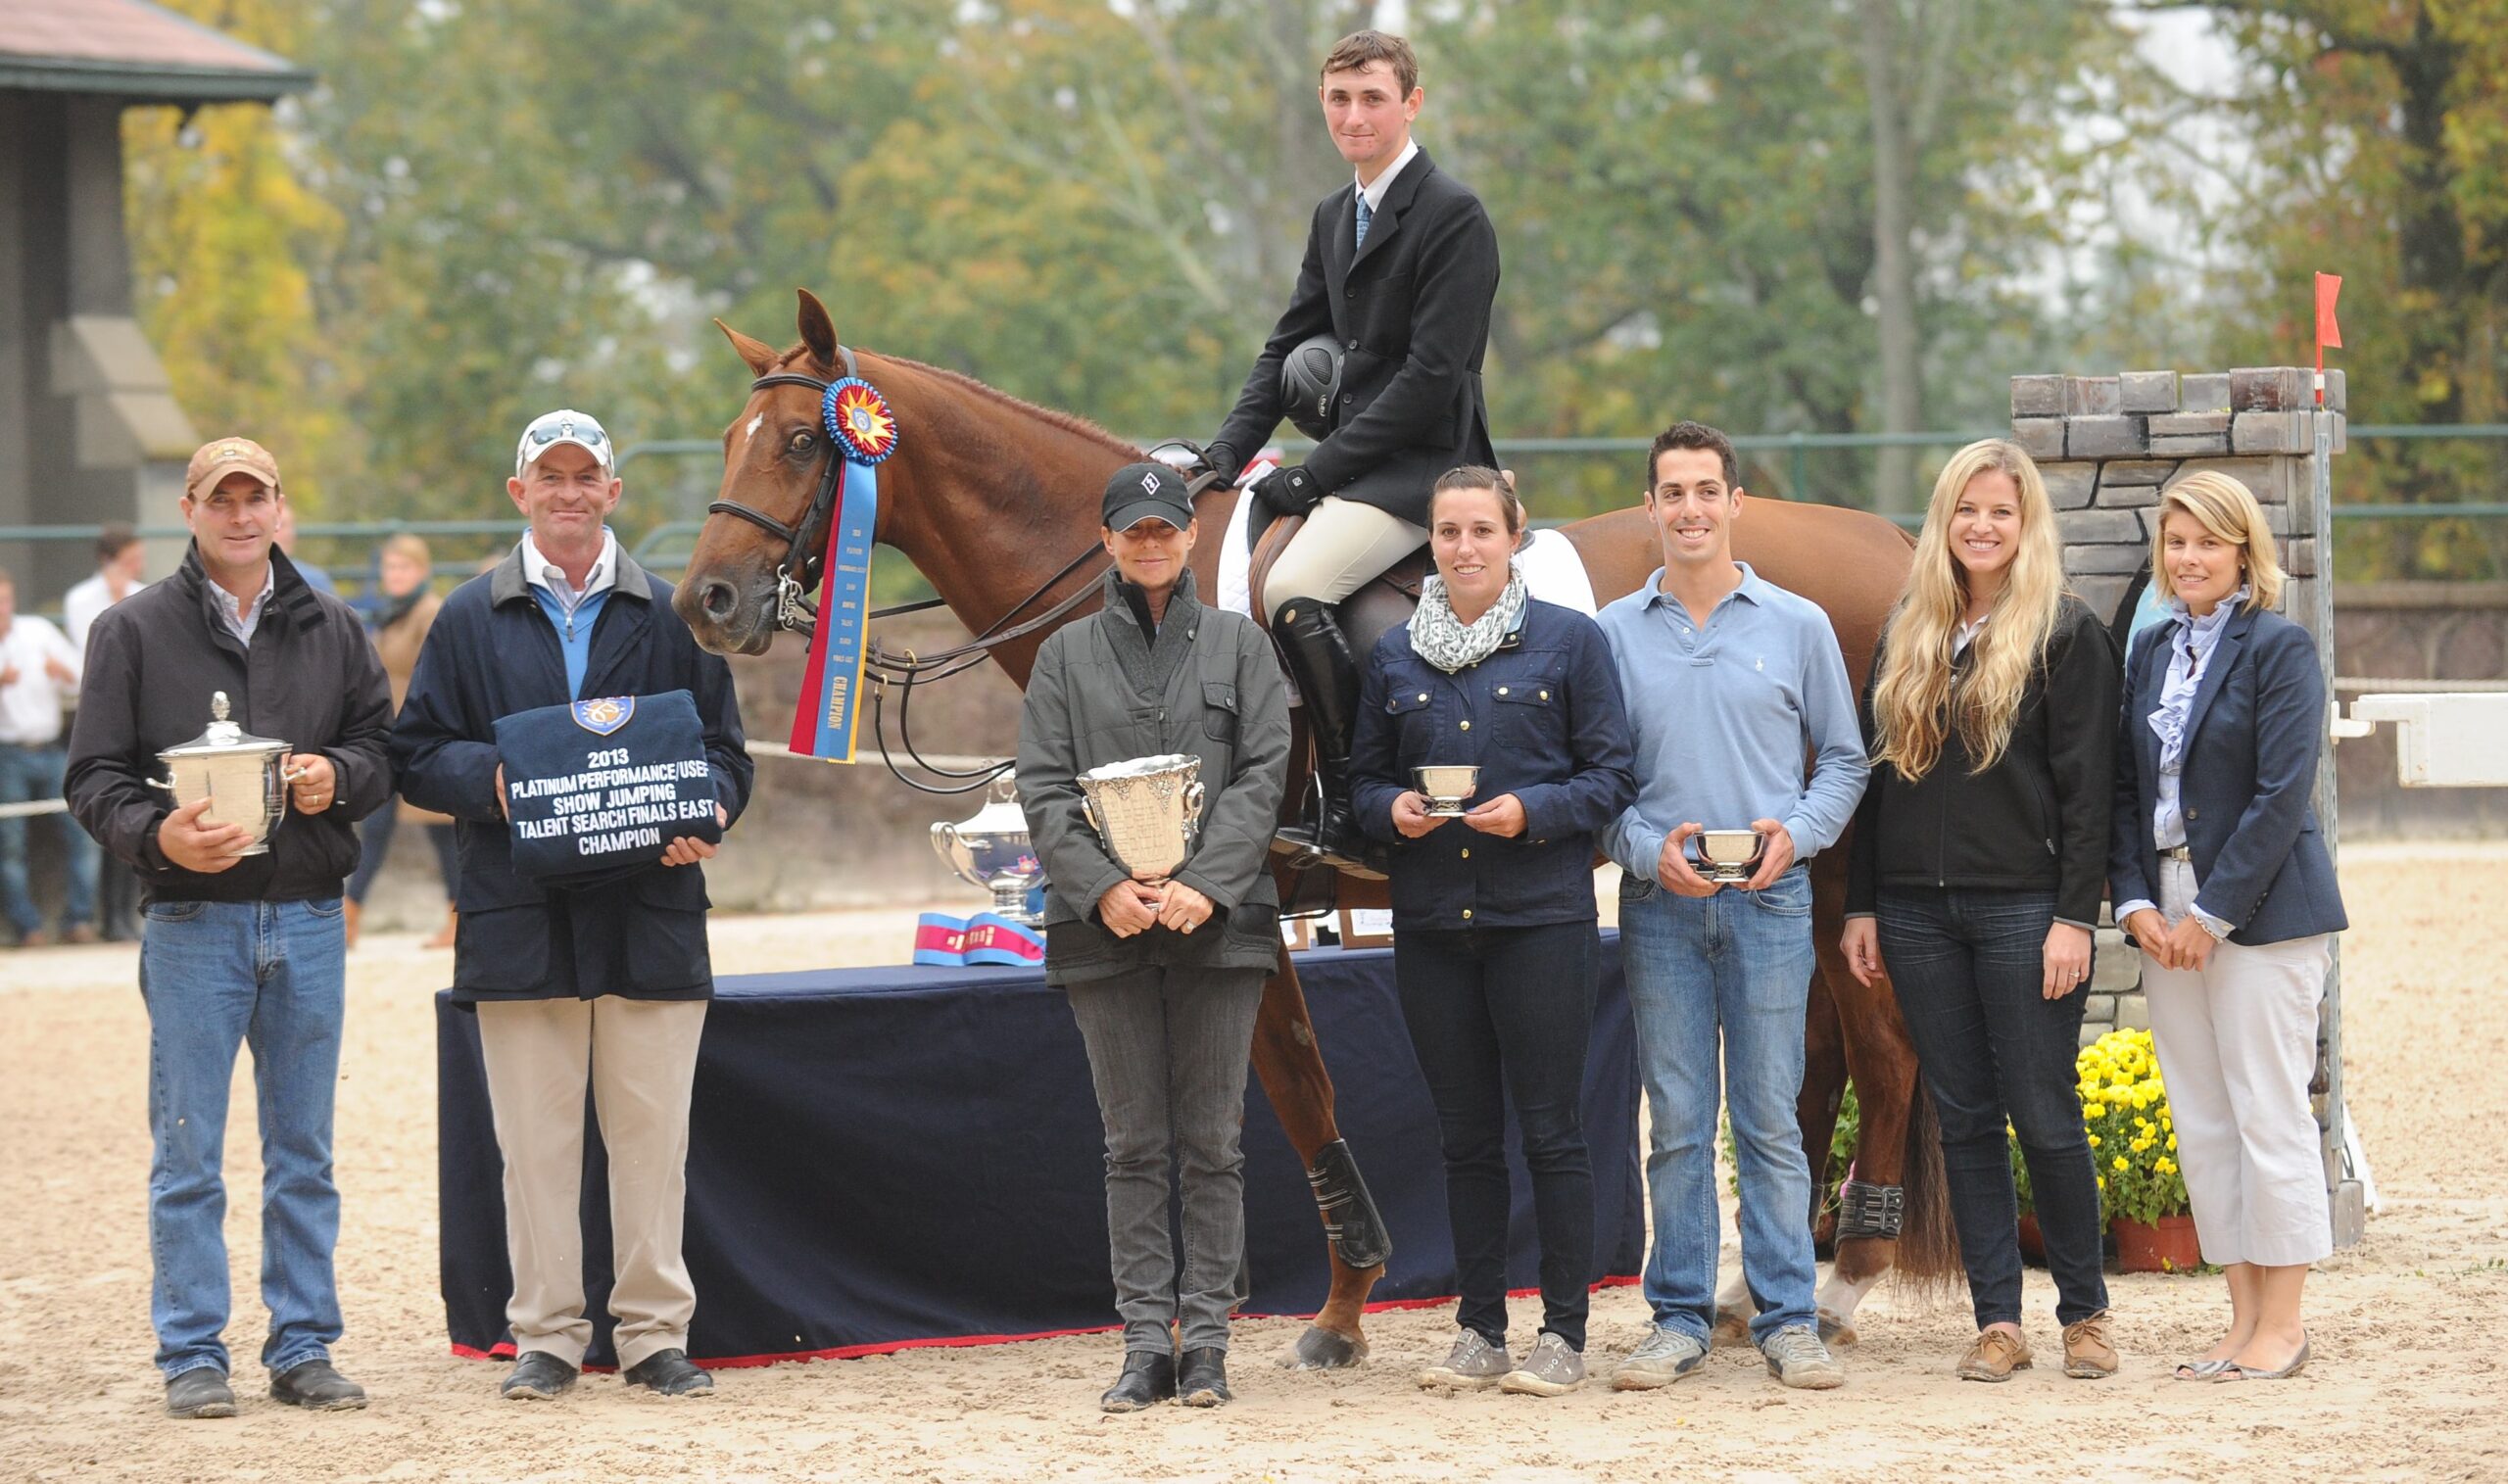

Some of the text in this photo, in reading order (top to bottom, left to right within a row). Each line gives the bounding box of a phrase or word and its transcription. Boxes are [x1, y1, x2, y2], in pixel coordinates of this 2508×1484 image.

[827, 676, 848, 730] CHAMPION
[588, 747, 629, 769] 2013
[510, 774, 578, 800] PLATINUM
[553, 783, 676, 816] SHOW JUMPING
[516, 798, 715, 839] TALENT SEARCH FINALS EAST
[578, 827, 661, 856] CHAMPION
